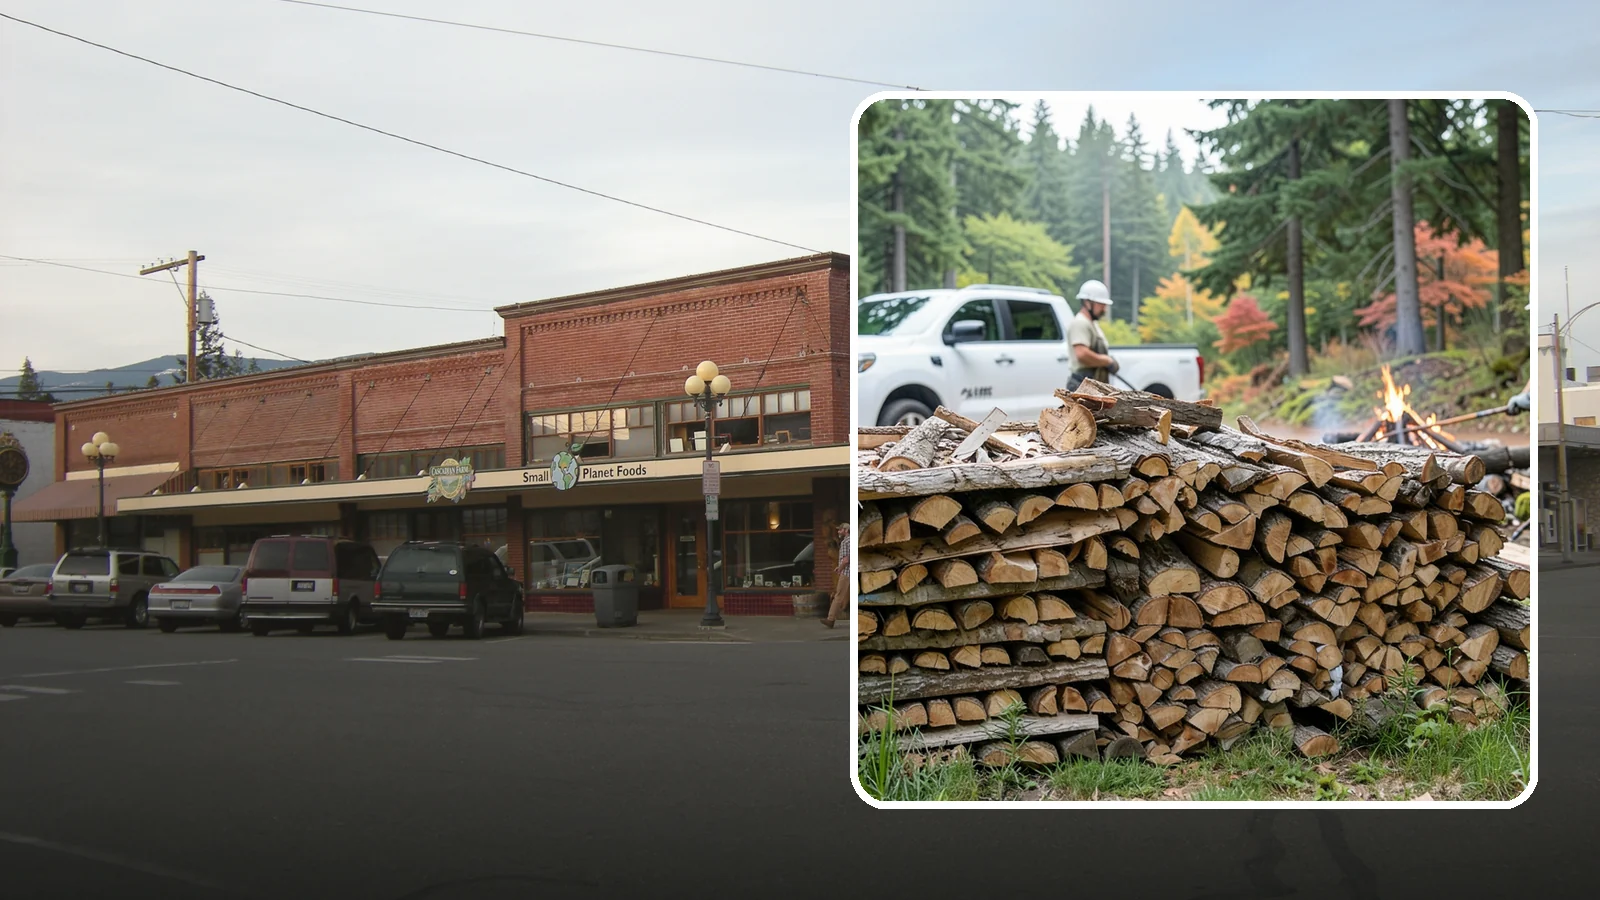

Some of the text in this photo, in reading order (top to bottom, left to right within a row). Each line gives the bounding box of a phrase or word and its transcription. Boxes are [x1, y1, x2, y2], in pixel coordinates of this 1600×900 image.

[432, 465, 469, 475] CASCADIAN FARM
[523, 464, 647, 483] Small Planet Foods
